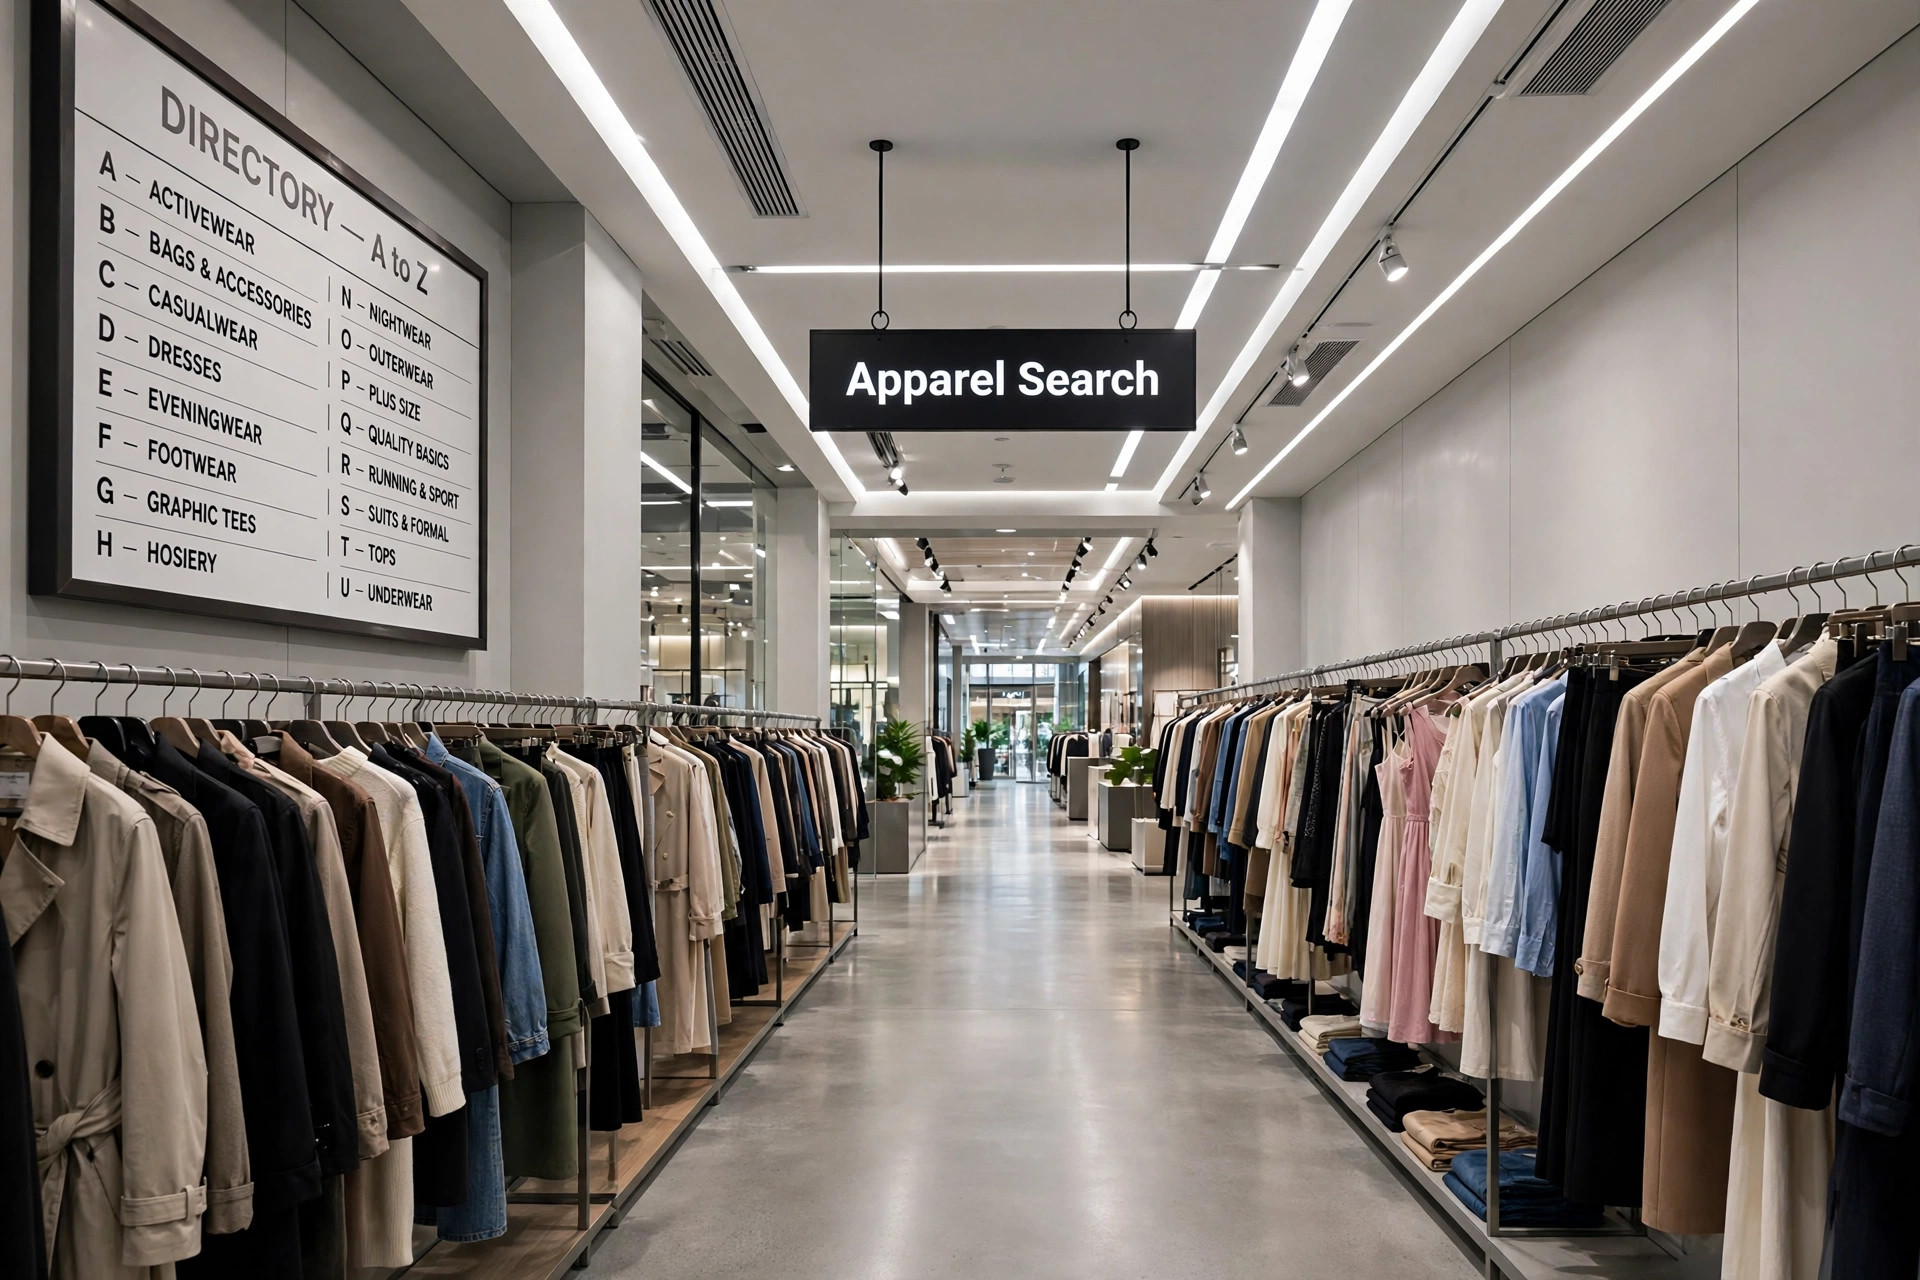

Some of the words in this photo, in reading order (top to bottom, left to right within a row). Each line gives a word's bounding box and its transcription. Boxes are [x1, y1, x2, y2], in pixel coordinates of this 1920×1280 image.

[99, 150, 117, 182] A
[148, 180, 256, 256] ACTIVEWEAR
[161, 86, 335, 232] DIRECTORY
[370, 234, 387, 270] A
[391, 246, 411, 283] to
[416, 261, 428, 296] Z
[99, 203, 116, 235] B
[148, 230, 196, 272] BAGS
[200, 257, 212, 281] &
[215, 266, 312, 330] ACCESSORIES
[98, 260, 116, 289] C
[148, 284, 258, 351] CASUALWEAR
[341, 285, 352, 310] N
[369, 302, 432, 351] NIGHTWEAR
[98, 312, 115, 343] D
[148, 334, 222, 383] DRESSES
[341, 328, 352, 350] O
[369, 343, 434, 390] OUTERWEAR
[98, 368, 113, 398] E
[148, 387, 262, 446] EVENINGWEAR
[341, 369, 351, 391] P
[369, 383, 397, 411] PLUS
[398, 397, 421, 422] SIZE
[845, 359, 1005, 406] Apparel
[1018, 359, 1159, 396] Search
[98, 421, 112, 449] F
[148, 438, 237, 484] FOOTWEAR
[340, 411, 352, 436] Q
[368, 424, 414, 457] QUALITY
[416, 442, 450, 471] BASICS
[97, 476, 114, 505] G
[147, 490, 218, 526] GRAPHIC
[221, 507, 257, 534] TEES
[341, 453, 351, 476] R
[368, 464, 417, 496] RUNNING
[419, 483, 427, 500] &
[429, 485, 460, 510] SPORT
[340, 494, 350, 516] S
[368, 504, 399, 529] SUITS
[401, 514, 409, 532] &
[410, 516, 450, 543] FORMAL
[97, 529, 113, 558] H
[147, 540, 218, 574] HOSIERY
[340, 535, 350, 557] T
[367, 543, 396, 566] TOPS
[341, 576, 350, 598] U
[368, 583, 433, 612] UNDERWEAR
